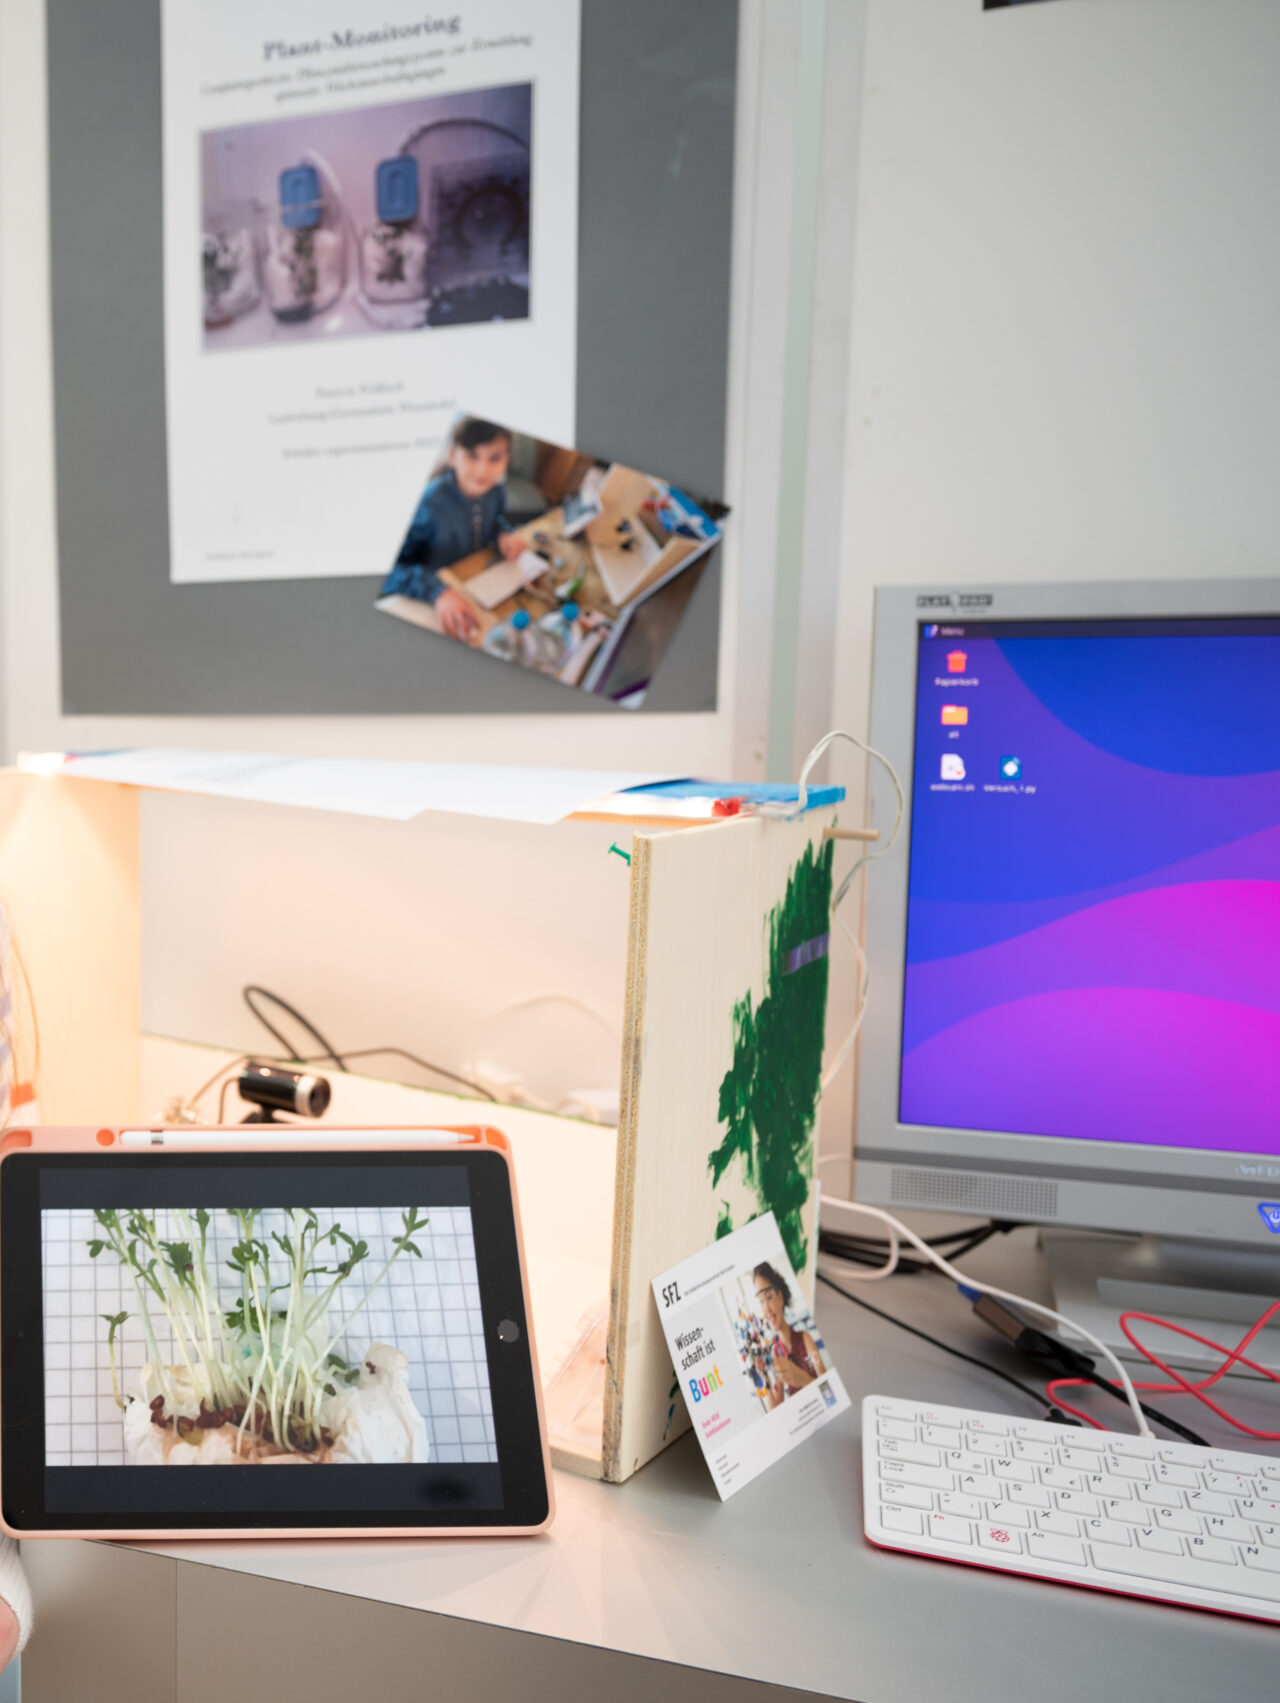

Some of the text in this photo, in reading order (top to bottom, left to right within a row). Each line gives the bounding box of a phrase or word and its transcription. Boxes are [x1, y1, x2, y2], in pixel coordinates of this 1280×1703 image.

[662, 1281, 682, 1308] SFZ
[675, 1327, 704, 1351] Wissen-
[681, 1338, 716, 1371] schaft ist
[688, 1364, 724, 1403] Bunt
[998, 1459, 1011, 1467] W
[1192, 1491, 1202, 1499] Z
[1161, 1509, 1172, 1517] G
[1247, 1547, 1259, 1555] N
